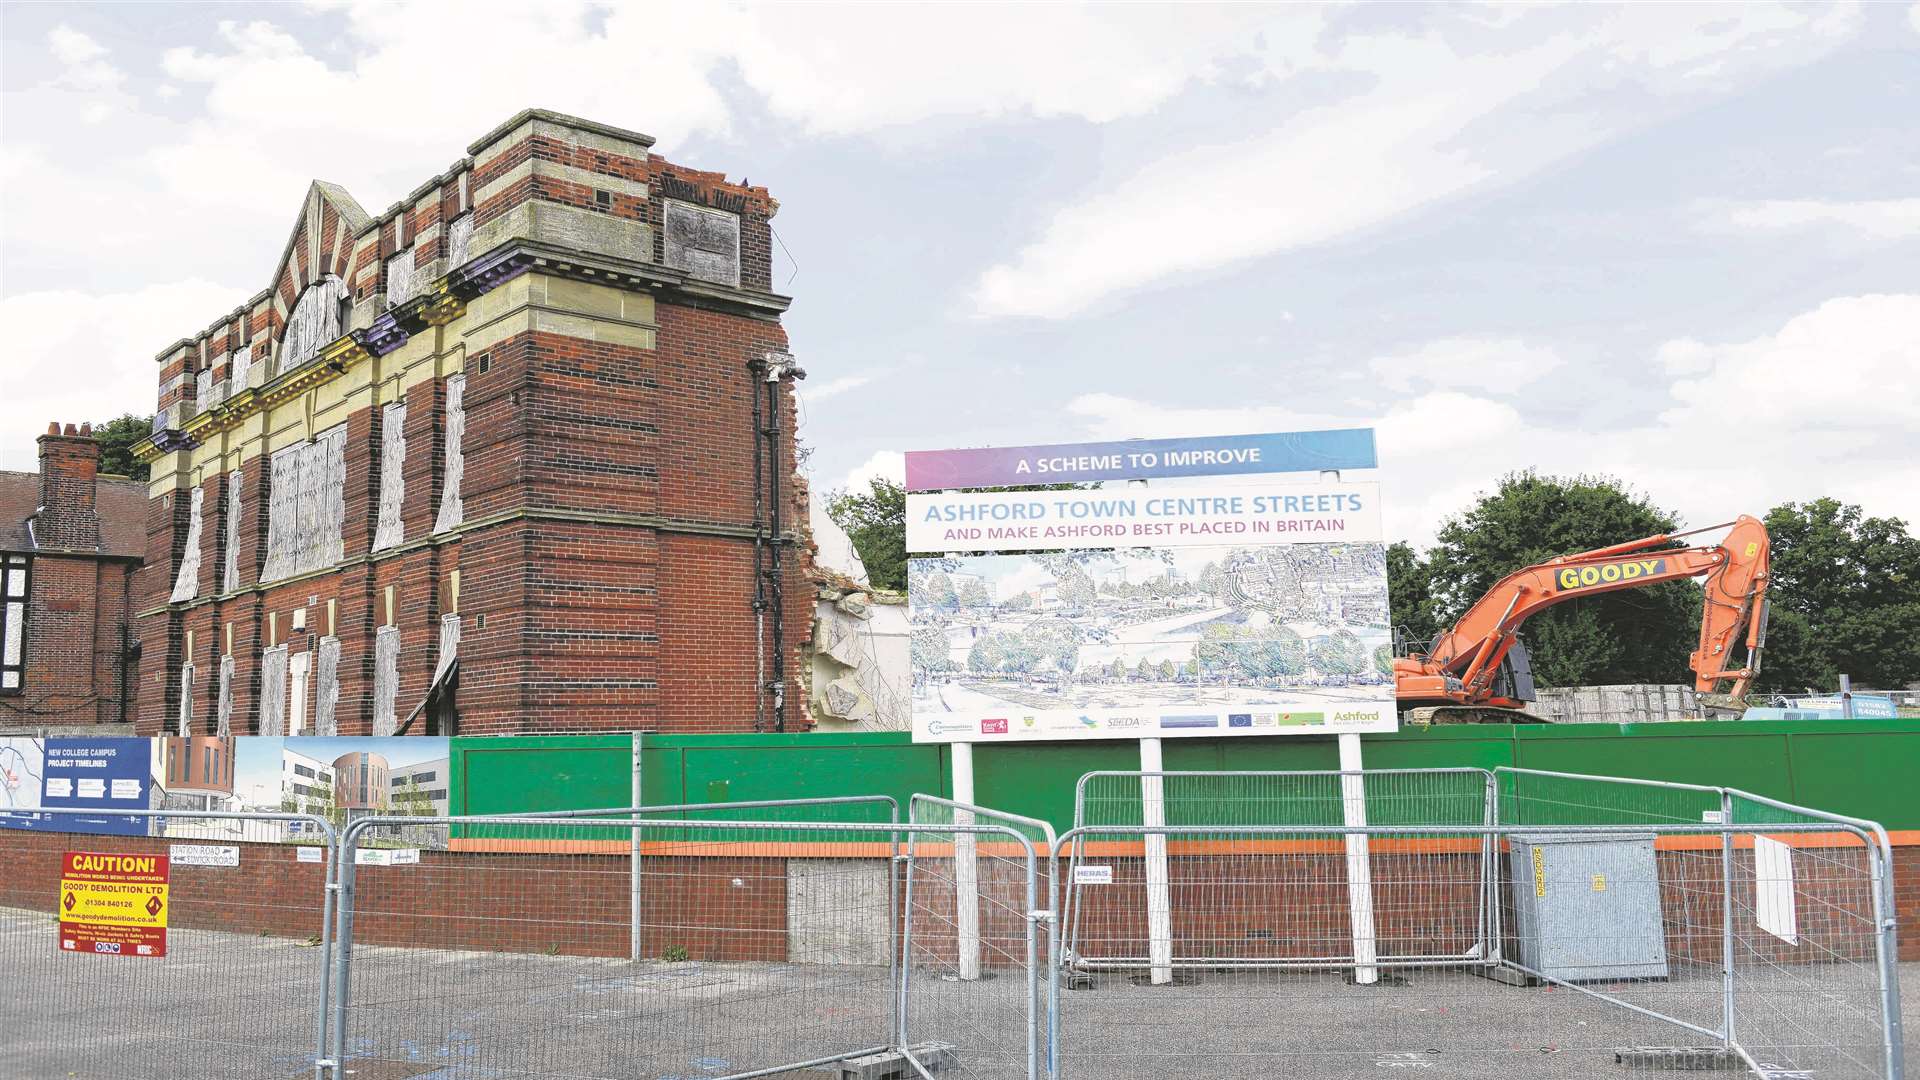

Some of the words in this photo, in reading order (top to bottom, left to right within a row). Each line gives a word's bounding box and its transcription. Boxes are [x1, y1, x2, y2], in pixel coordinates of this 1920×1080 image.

[1016, 459, 1031, 474] A
[1037, 455, 1123, 473] SCHEME
[1128, 454, 1158, 469] TO
[1164, 448, 1261, 468] IMPROVE
[924, 502, 1046, 522] ASHFORD
[1052, 499, 1137, 519] TOWN
[1145, 497, 1243, 517] CENTRE
[1252, 494, 1362, 514] STREETS
[944, 526, 982, 540] AND
[987, 526, 1038, 539] MAKE
[1044, 523, 1126, 538] ASHFORD
[1132, 522, 1174, 536] BEST
[1179, 520, 1246, 535] PLACED
[1251, 520, 1270, 533] IN
[1276, 519, 1345, 533] BRITAIN
[1559, 559, 1659, 590] GOODY
[1334, 711, 1379, 722] Ashford
[47, 760, 73, 768] PROJECT
[75, 760, 107, 768] TIMELINES
[171, 846, 198, 855] STATION
[201, 846, 220, 855] ROAD
[72, 854, 156, 873] CAUTION!
[213, 857, 234, 865] ROAD
[91, 884, 143, 893] DEMOLITION
[146, 886, 163, 894] LTD
[108, 900, 133, 908] 840126
[66, 913, 157, 923] www.goodydemolition.co.uk
